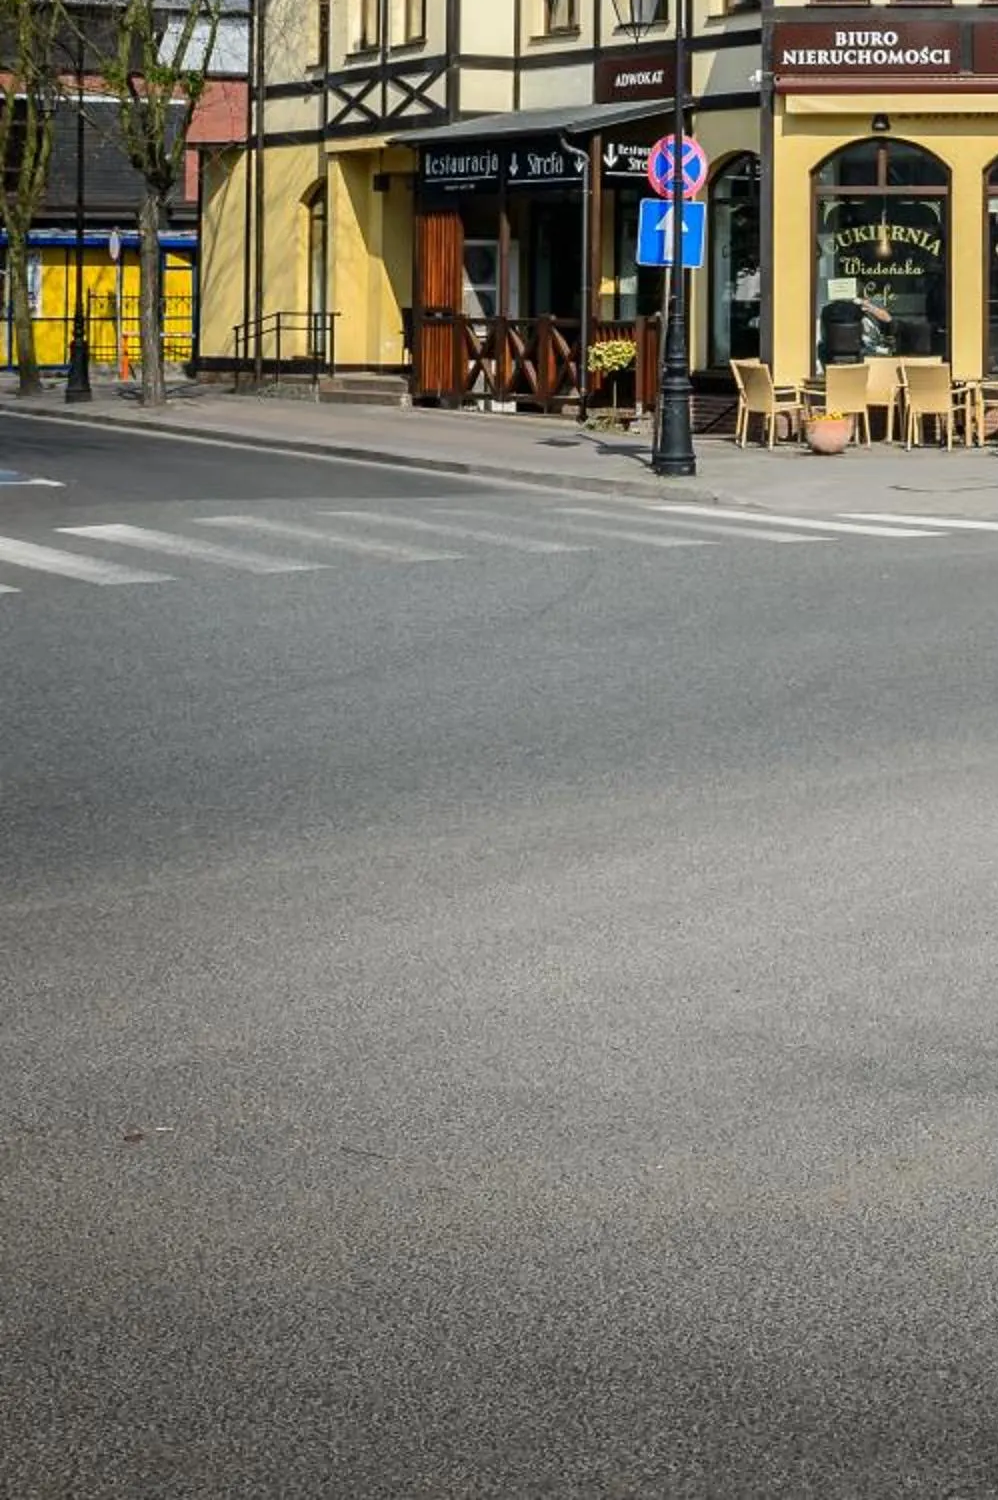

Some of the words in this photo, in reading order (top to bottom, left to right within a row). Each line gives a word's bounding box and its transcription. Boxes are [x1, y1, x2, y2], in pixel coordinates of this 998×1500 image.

[835, 31, 898, 46] BIURO
[781, 46, 951, 65] NIERUCHOMOŚCI
[614, 70, 664, 87] ADWOKAT
[823, 225, 941, 256] CUKIERNIA
